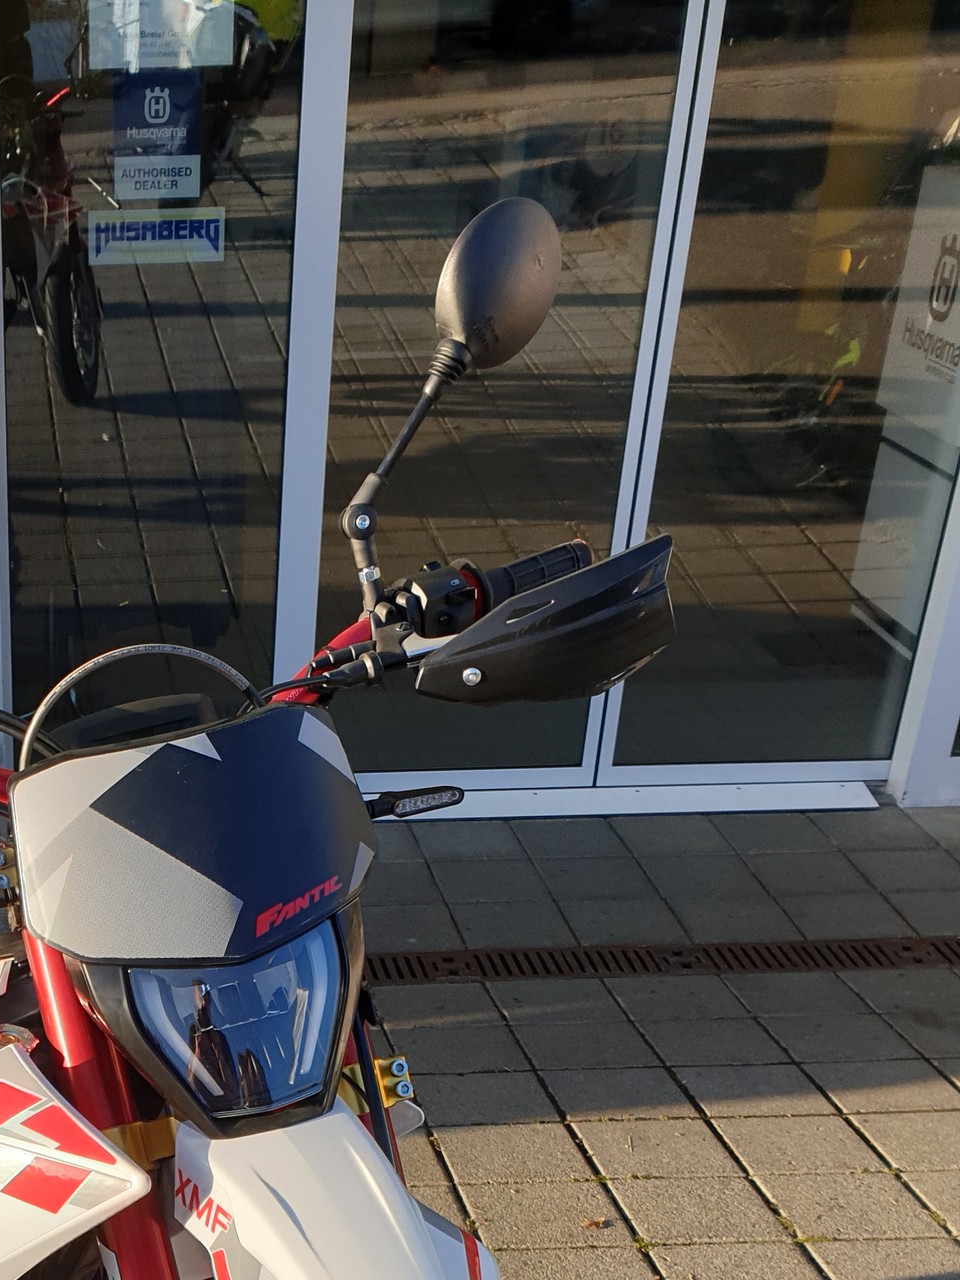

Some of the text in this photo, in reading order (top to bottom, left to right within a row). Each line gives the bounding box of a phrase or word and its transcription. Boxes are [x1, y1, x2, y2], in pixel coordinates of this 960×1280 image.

[126, 126, 187, 140] Husqvarna
[121, 166, 193, 179] AUTHORISED
[134, 179, 178, 191] DEALER
[95, 218, 220, 259] HUSABERG
[254, 875, 343, 939] FANTIC
[175, 1168, 233, 1233] XMF
